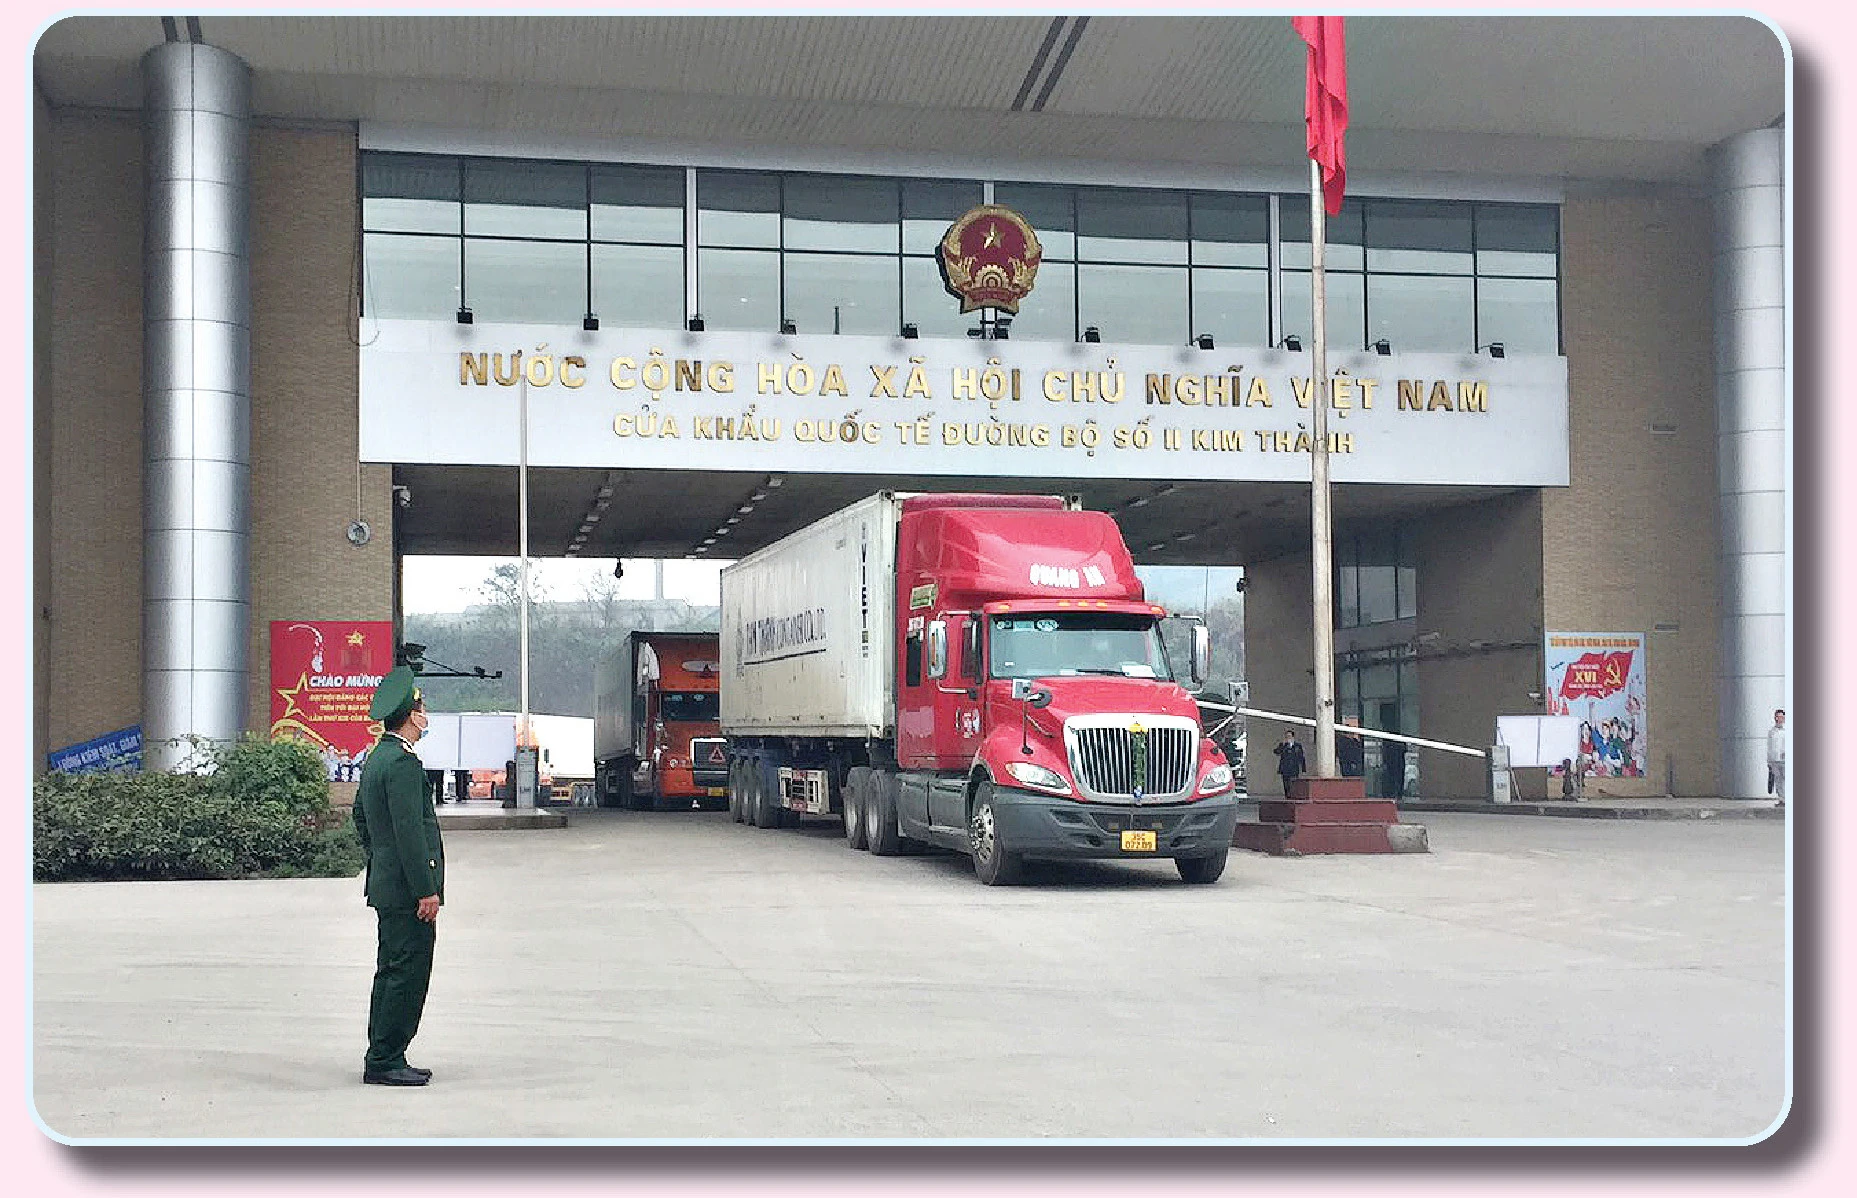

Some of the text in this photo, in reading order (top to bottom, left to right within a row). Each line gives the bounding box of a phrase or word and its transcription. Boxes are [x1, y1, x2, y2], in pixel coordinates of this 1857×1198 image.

[460, 342, 1490, 419] NƯỚC CỘNG HÒA XÃ HỘI CHỦ NGHĨA VỆT NAM
[613, 404, 680, 438] CỬA
[693, 404, 782, 441] KHẨU
[794, 409, 881, 443] QUỐC
[894, 411, 935, 445] TẾ
[1061, 418, 1101, 457] BỘ
[1113, 415, 1154, 449] SỐ
[1163, 428, 1181, 451] II
[1191, 428, 1244, 452] KIM
[310, 672, 344, 688] CHÀO
